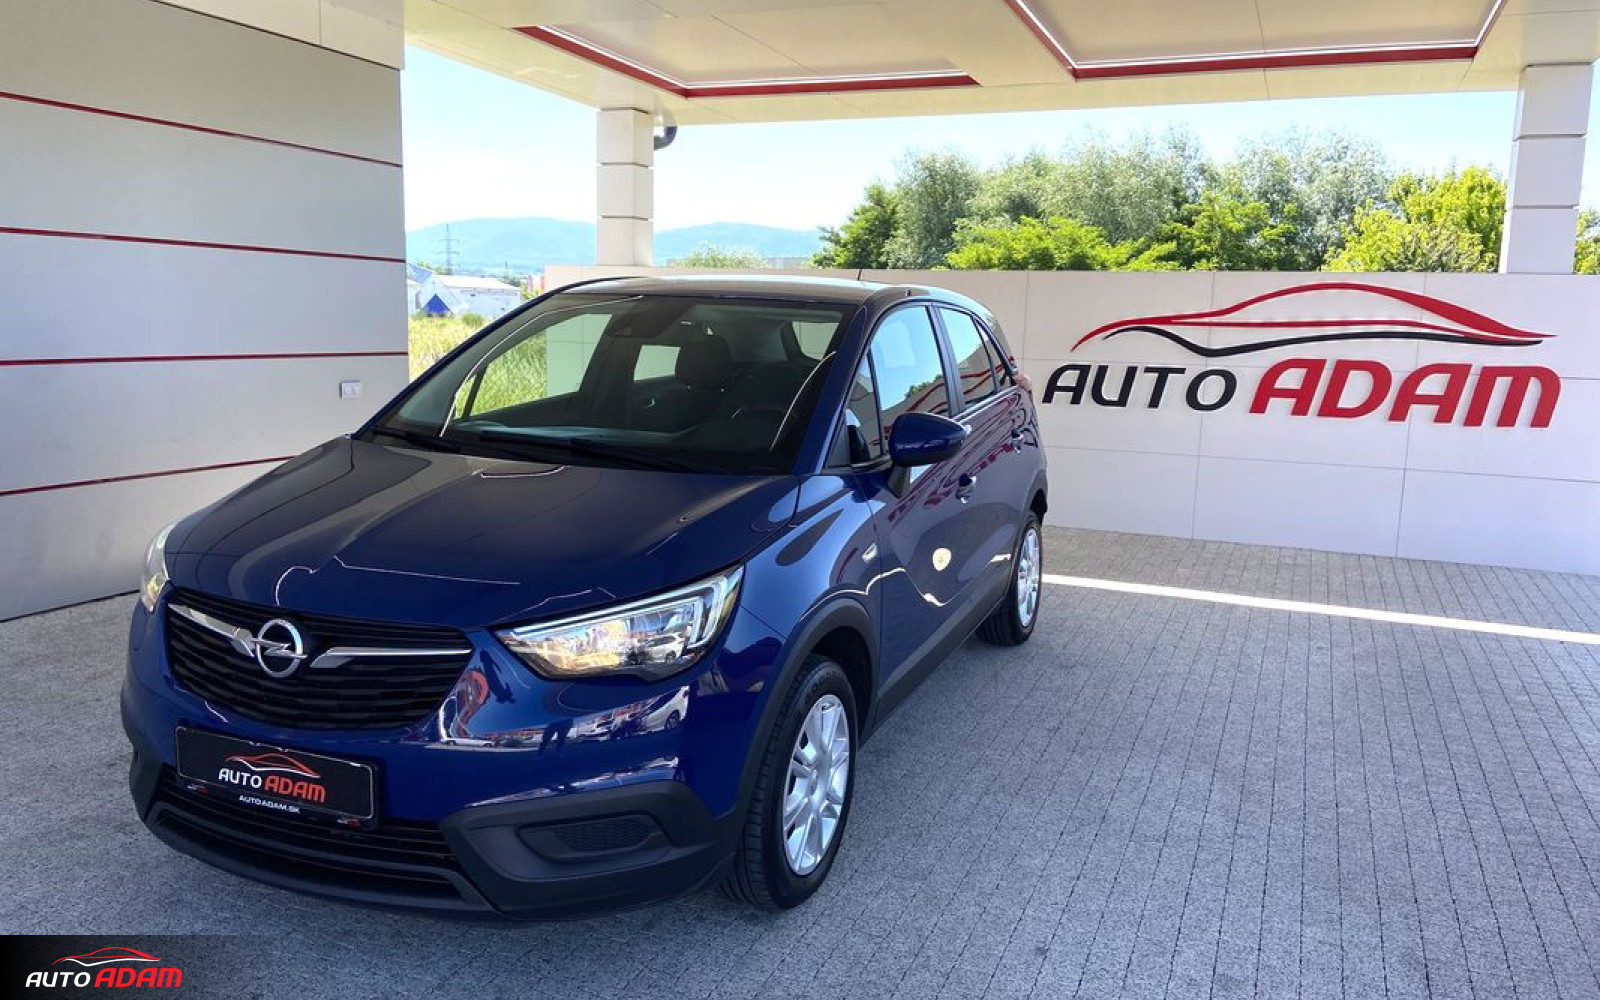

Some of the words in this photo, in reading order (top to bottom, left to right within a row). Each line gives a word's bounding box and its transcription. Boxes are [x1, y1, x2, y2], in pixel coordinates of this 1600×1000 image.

[1042, 362, 1238, 411] AUTO
[1248, 358, 1562, 428] ADAM
[218, 768, 262, 789] AUTO
[264, 775, 326, 804] ADAM
